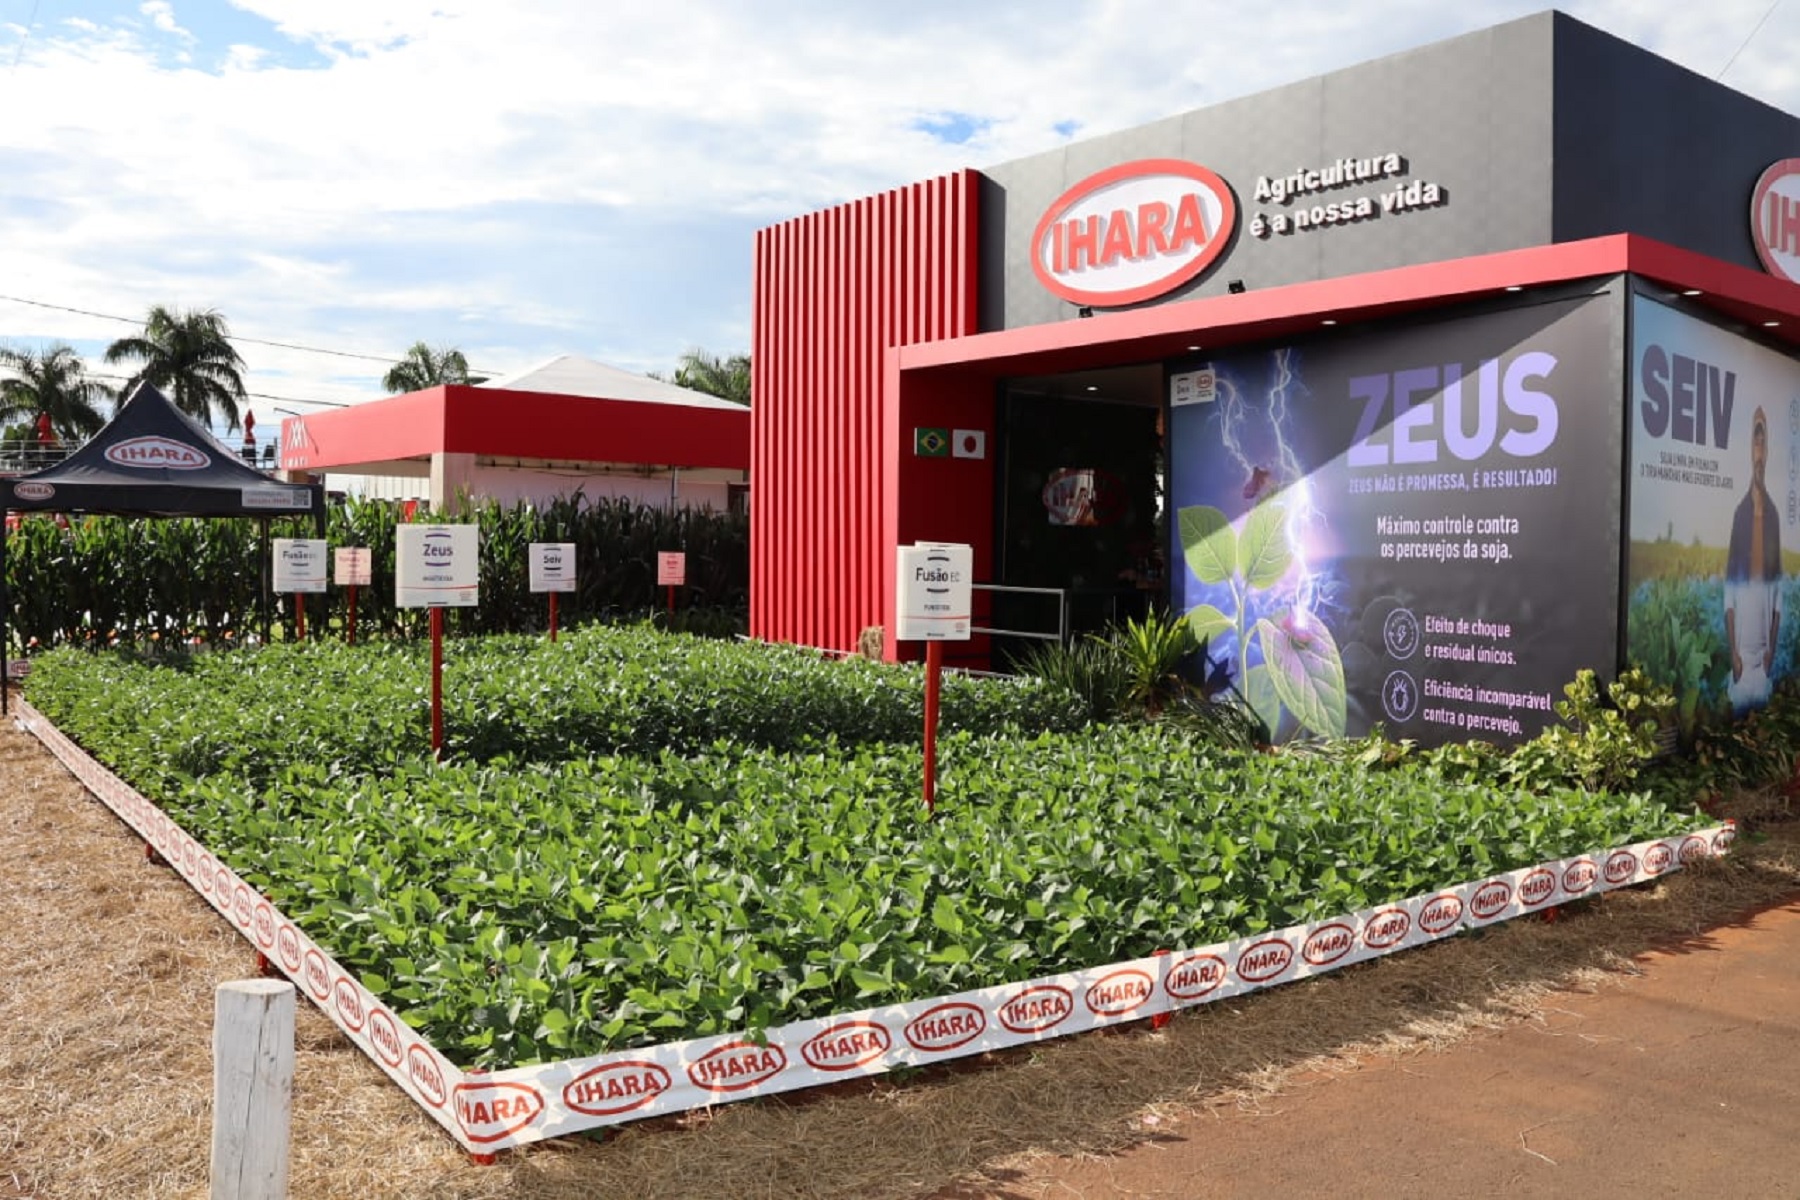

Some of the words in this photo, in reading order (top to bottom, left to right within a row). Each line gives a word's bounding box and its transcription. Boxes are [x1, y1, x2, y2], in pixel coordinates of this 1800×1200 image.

[1254, 152, 1401, 204] Agricultura
[1250, 213, 1268, 237] é
[1272, 211, 1288, 232] a
[1296, 194, 1372, 229] nossa
[1380, 179, 1440, 212] vida
[1051, 192, 1209, 275] IHARA
[1347, 351, 1559, 468] ZEUS
[1640, 344, 1737, 450] SEIV
[120, 446, 195, 463] IHARA
[1349, 477, 1372, 494] ZEUS
[1375, 473, 1395, 492] NÃO
[1398, 473, 1405, 491] É
[1407, 472, 1469, 492] PROMESSA,
[1473, 469, 1480, 488] É
[1483, 467, 1558, 488] RESULTADO!
[1377, 516, 1420, 536] Máximo
[1423, 514, 1474, 534] controle
[1477, 515, 1519, 534] contra
[422, 543, 453, 557] Zeus
[1381, 543, 1394, 558] os
[1397, 541, 1460, 562] percevejos
[1463, 539, 1478, 558] da
[1481, 541, 1513, 563] soja.
[916, 567, 949, 582] Fusão
[1425, 616, 1454, 633] Efeito
[1457, 618, 1469, 634] de
[1471, 619, 1511, 641] choque
[1425, 645, 1431, 657] e
[1433, 644, 1475, 661] residual
[1477, 645, 1517, 665] únicos.
[1424, 678, 1473, 702] Eficiência
[1476, 684, 1552, 711] incomparável
[1423, 706, 1456, 725] contra
[1458, 711, 1464, 725] o
[1467, 710, 1523, 736] percevejo.
[1522, 877, 1551, 897] IHARA
[1423, 903, 1459, 925] IHARA
[1367, 918, 1406, 940] IHARA
[1307, 933, 1349, 956] IHARA
[1242, 949, 1287, 973] IHARA
[1171, 964, 1220, 990] IHARA
[1092, 980, 1147, 1006] IHARA
[1006, 995, 1068, 1025] IHARA
[913, 1012, 979, 1042] IHARA
[810, 1032, 884, 1062] IHARA
[698, 1049, 777, 1082] IHARA
[574, 1071, 661, 1105] IHARA
